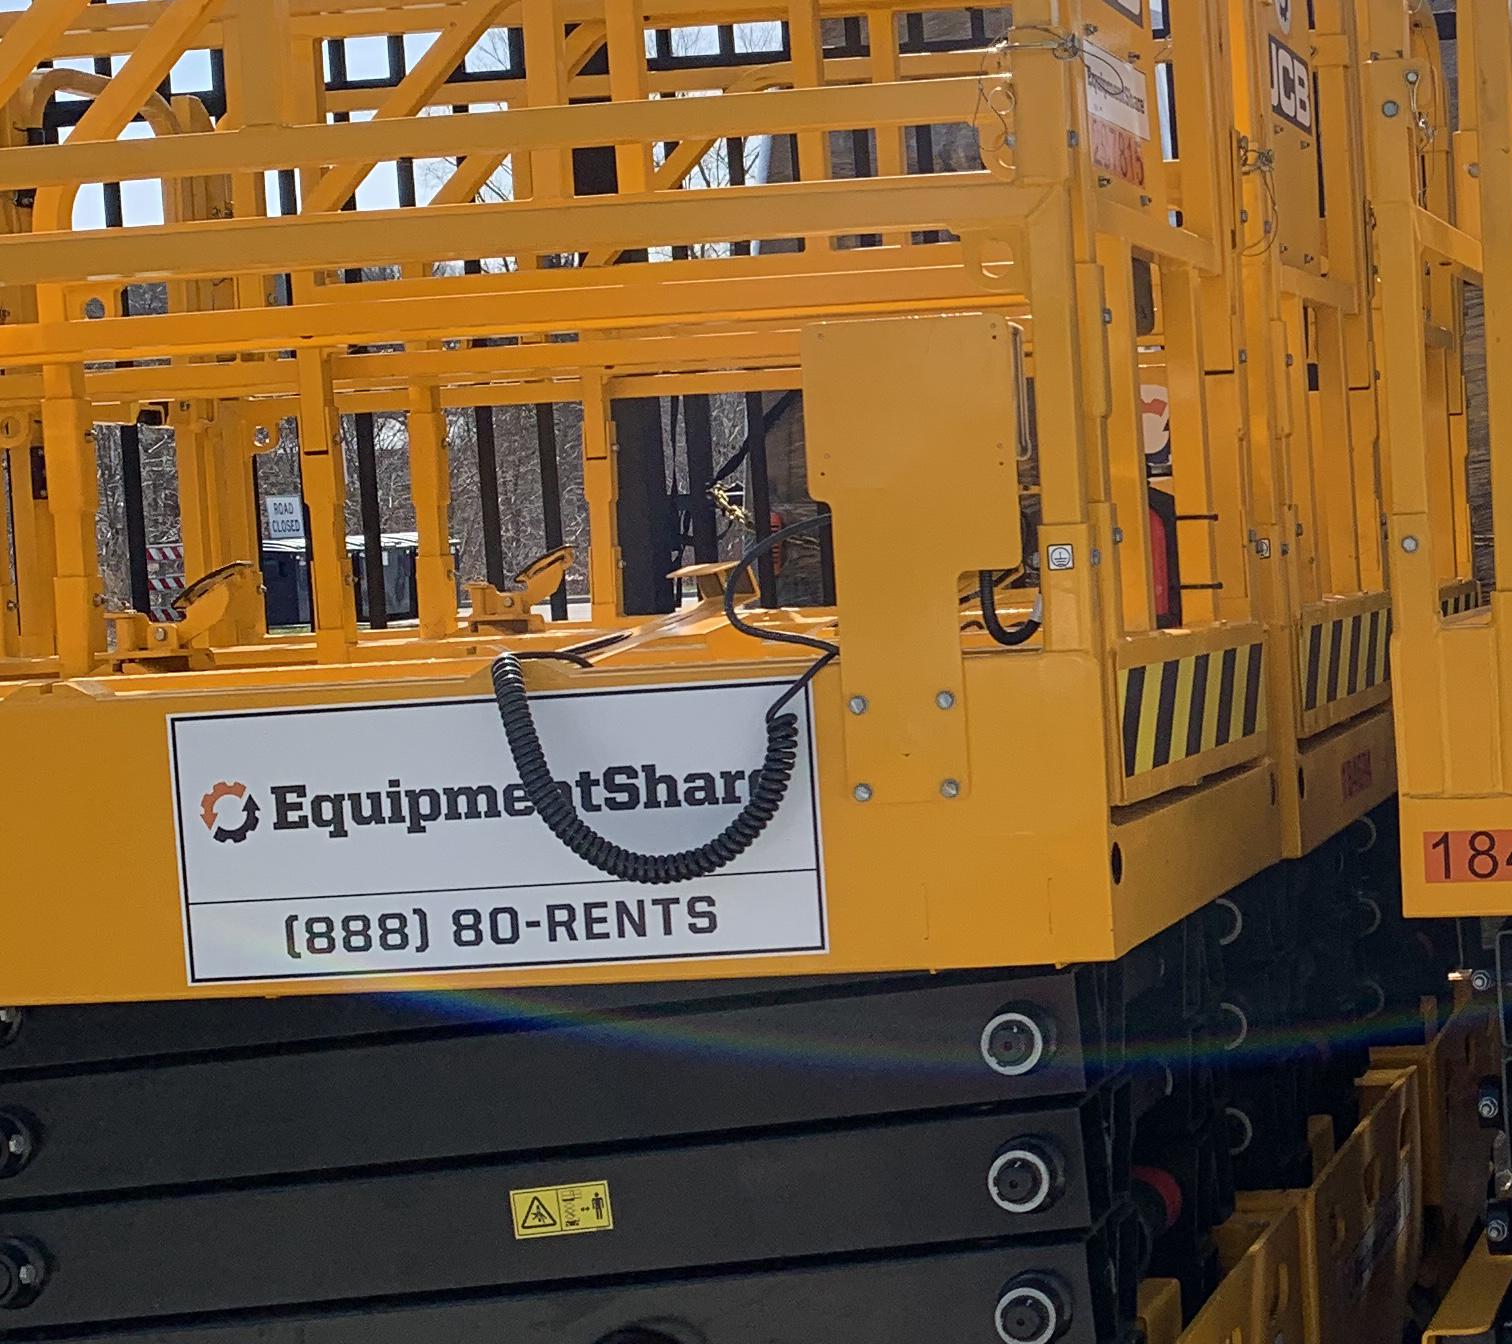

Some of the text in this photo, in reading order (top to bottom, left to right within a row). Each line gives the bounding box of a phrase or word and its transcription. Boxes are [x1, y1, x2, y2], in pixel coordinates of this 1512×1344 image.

[1271, 39, 1312, 129] JCB
[272, 519, 301, 533] CLOSED
[273, 502, 294, 515] ROAD
[285, 895, 719, 958] (888) 80-RENTS
